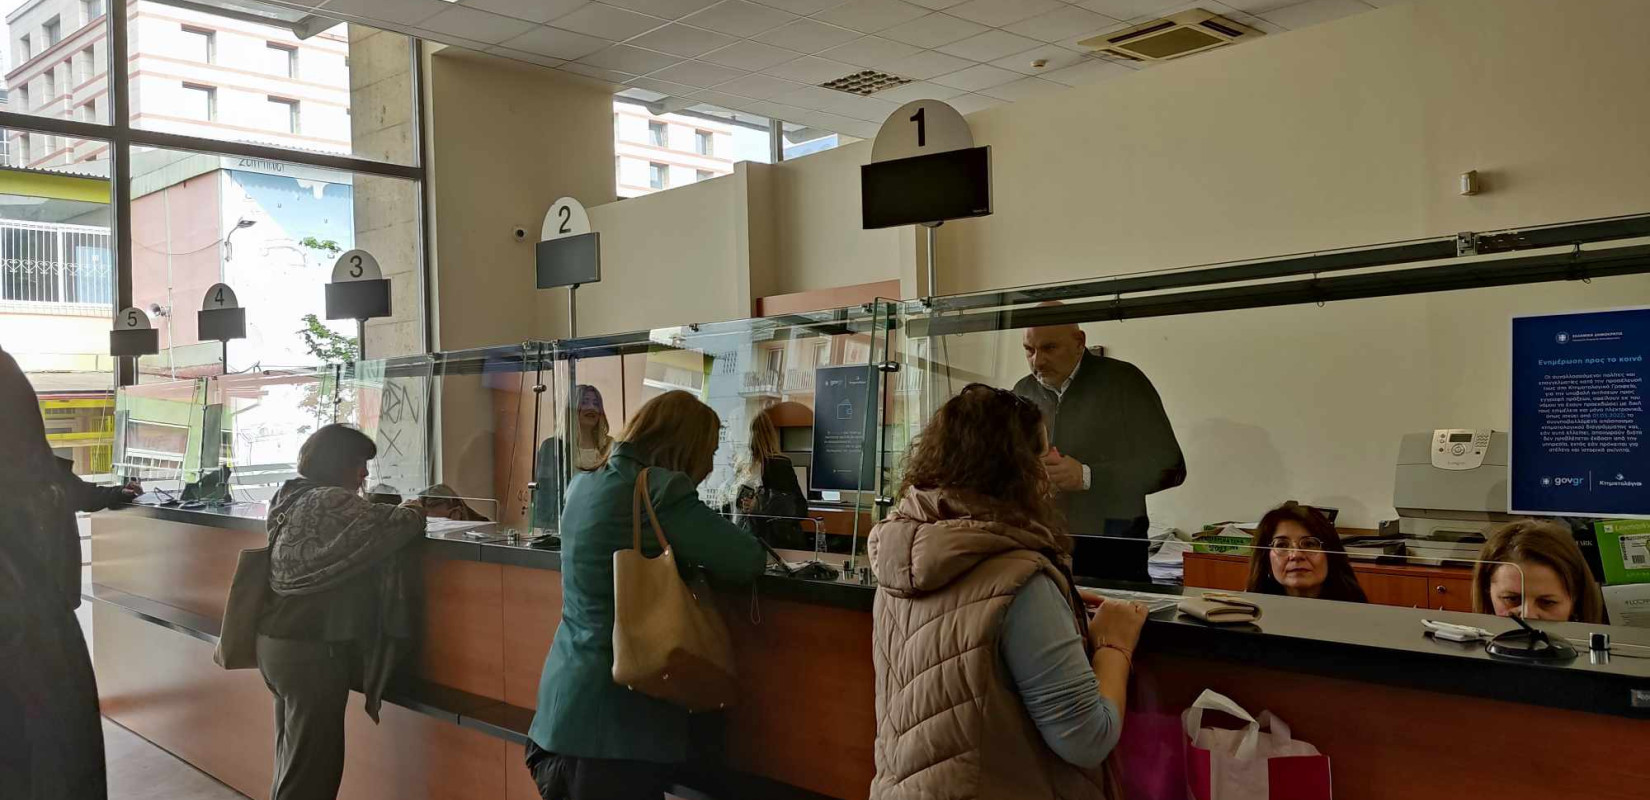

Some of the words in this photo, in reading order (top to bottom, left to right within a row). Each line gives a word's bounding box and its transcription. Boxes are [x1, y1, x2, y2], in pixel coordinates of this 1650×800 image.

[910, 107, 925, 147] 1
[559, 205, 571, 234] 2
[349, 255, 363, 278] 3
[214, 287, 225, 307] 4
[127, 311, 138, 327] 5
[1538, 358, 1582, 366] Ενημέρωση
[1584, 357, 1605, 365] προς
[1619, 354, 1642, 362] κοινό
[1554, 477, 1583, 486] govgr
